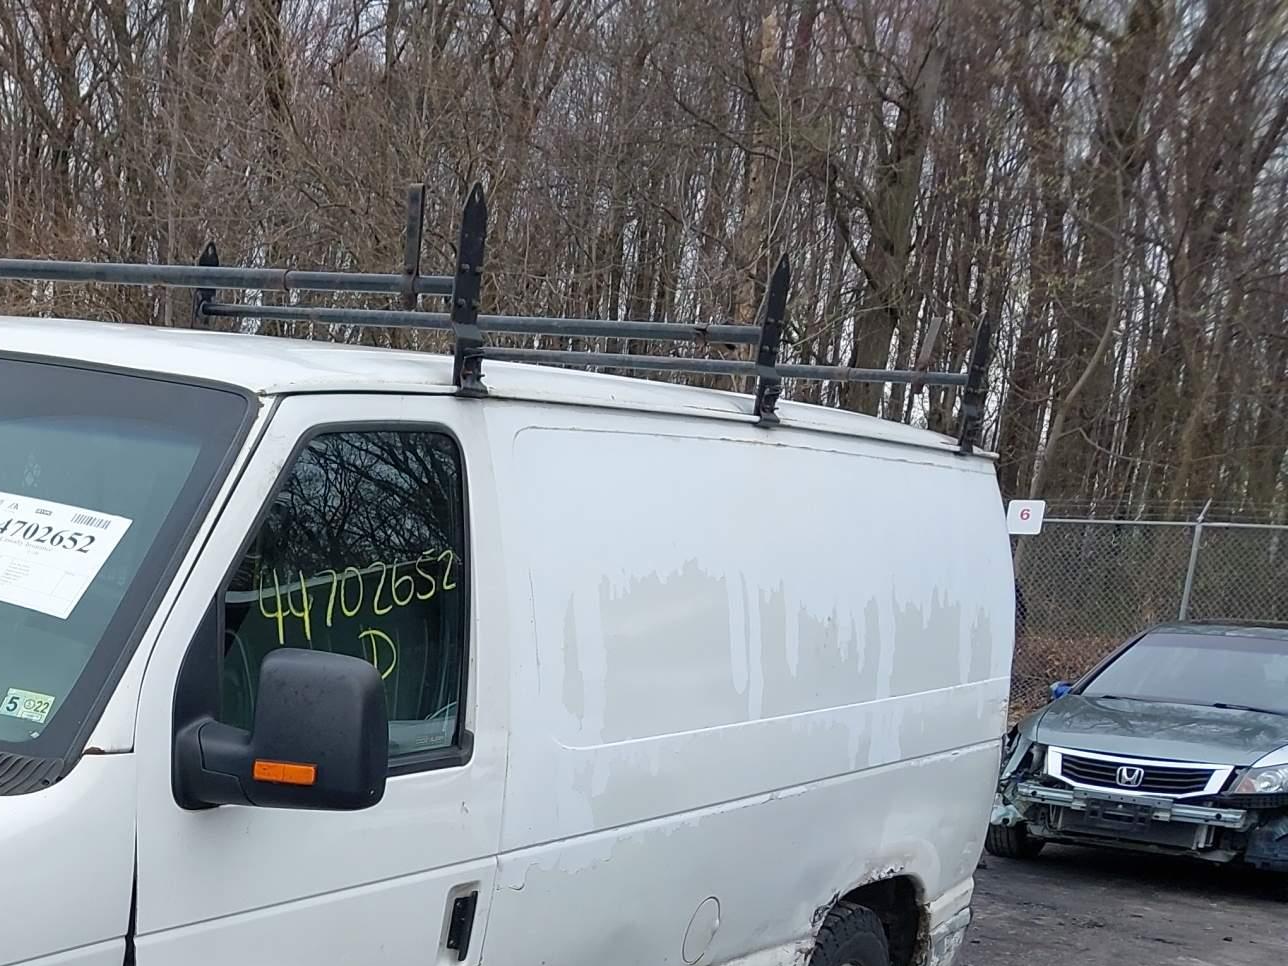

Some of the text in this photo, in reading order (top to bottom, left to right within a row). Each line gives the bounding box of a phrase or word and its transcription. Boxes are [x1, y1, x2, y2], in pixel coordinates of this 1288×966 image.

[1020, 508, 1031, 521] 6
[258, 548, 457, 645] 44702652
[358, 627, 398, 681] D
[5, 695, 50, 714] 5 22
